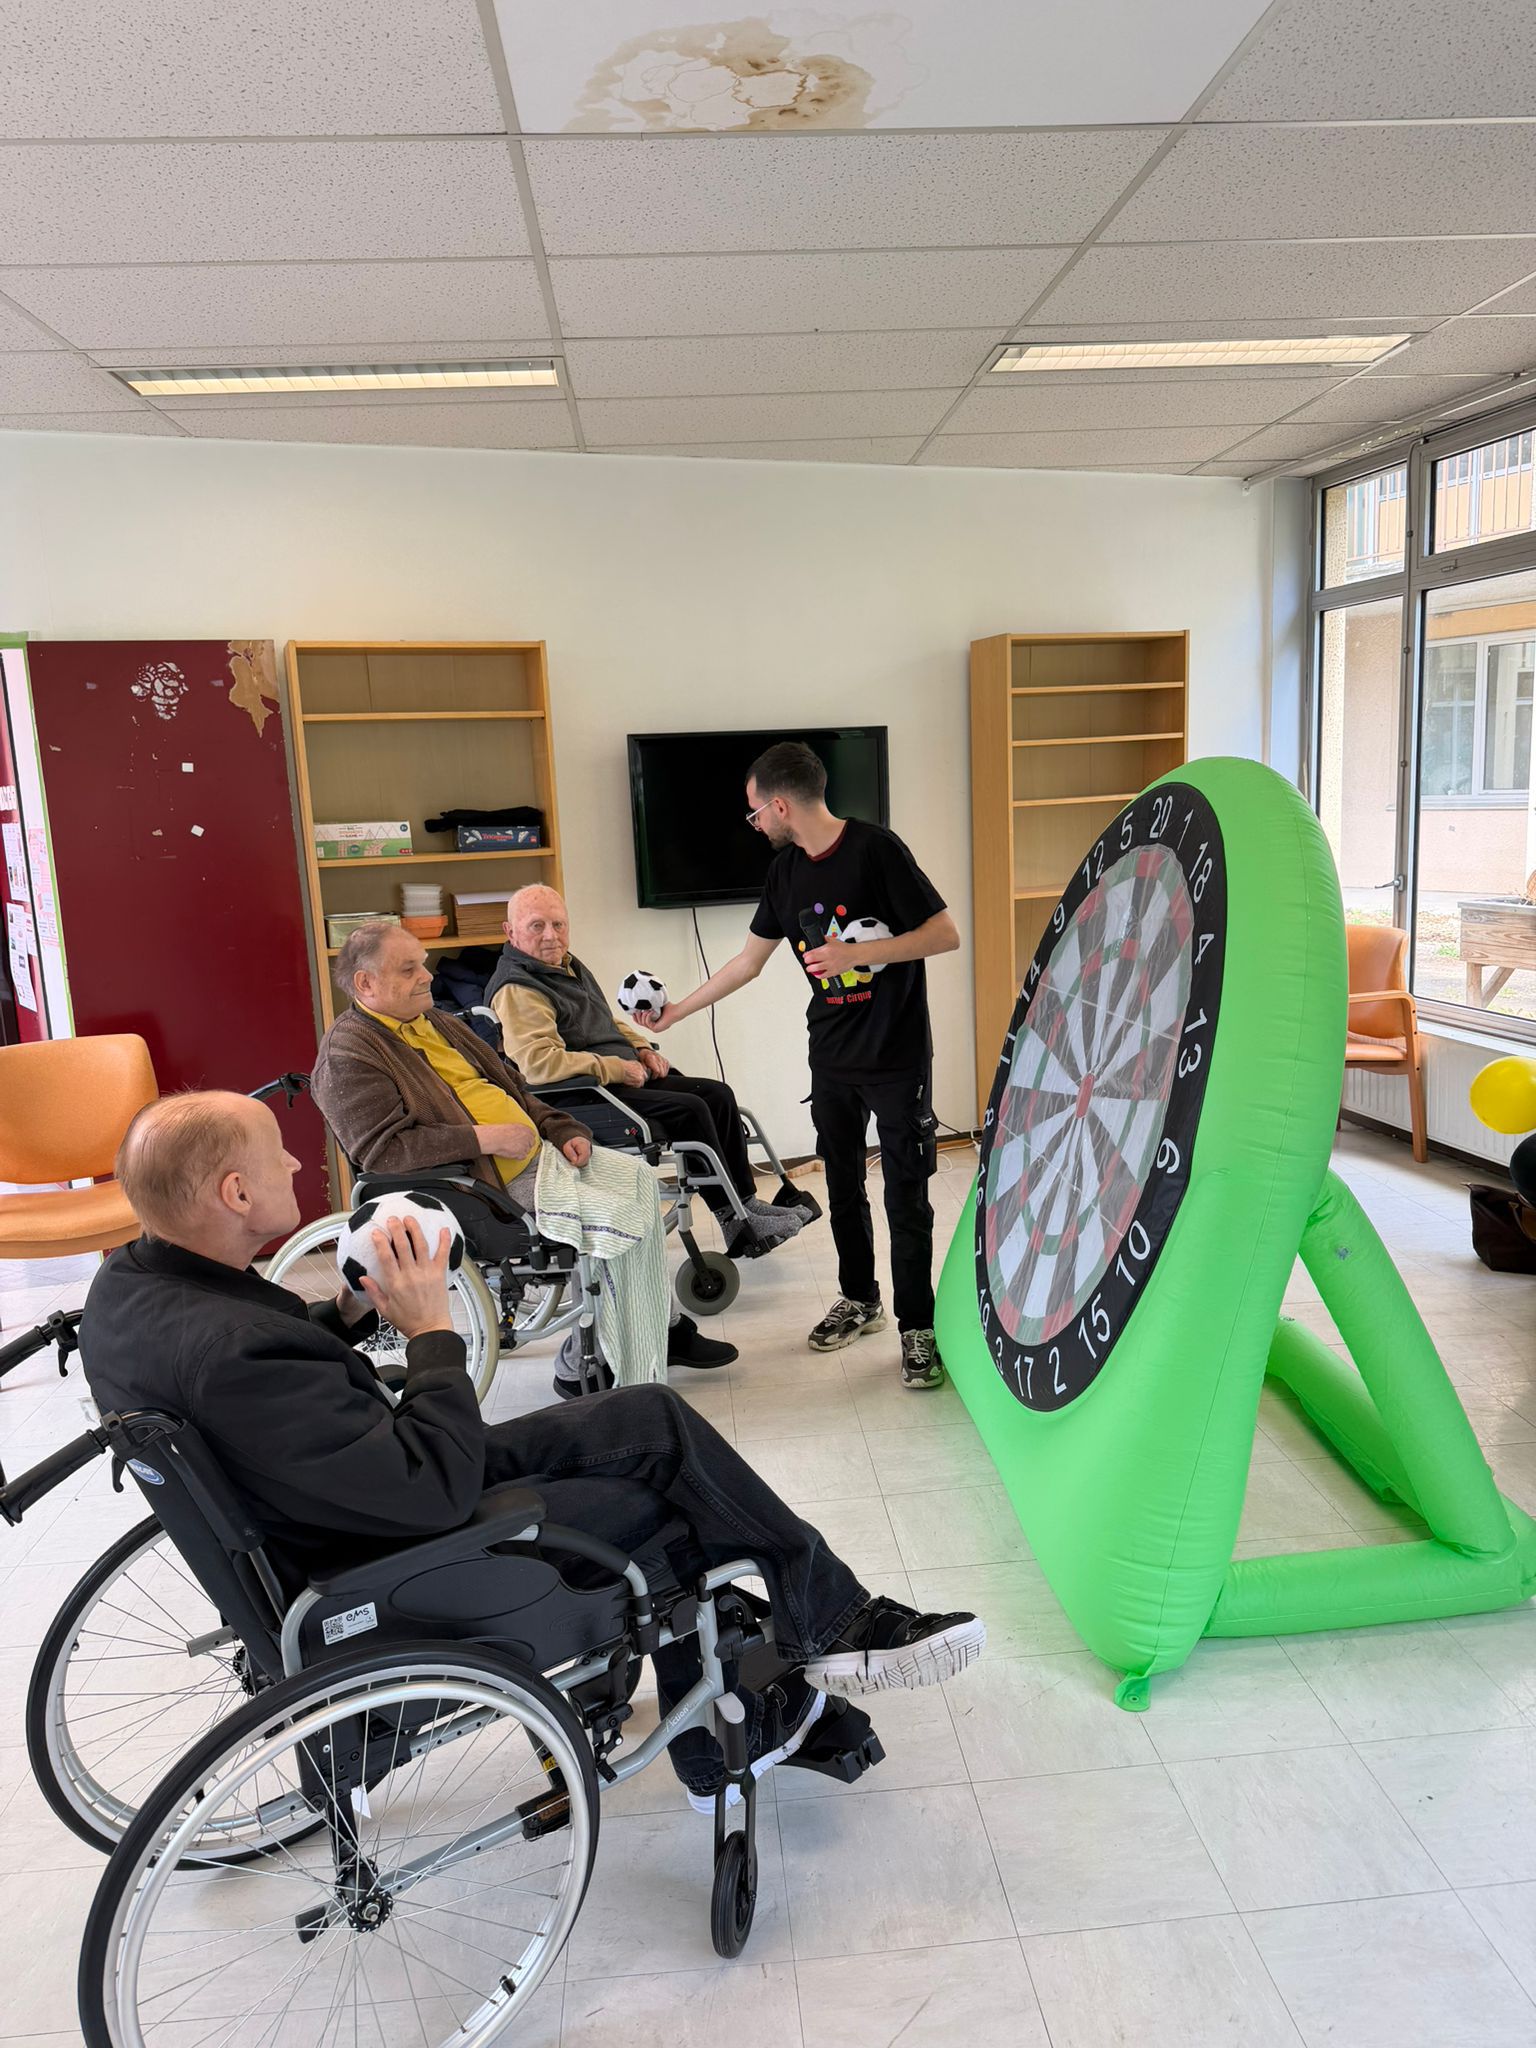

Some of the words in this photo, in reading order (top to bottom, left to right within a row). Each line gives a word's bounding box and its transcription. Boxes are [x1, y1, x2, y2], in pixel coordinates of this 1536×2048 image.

[1120, 812, 1134, 850] 5
[1149, 795, 1173, 839] 20
[1178, 809, 1194, 850] 1
[1082, 839, 1105, 889] 12
[1189, 841, 1213, 904] 18
[1053, 902, 1065, 934] 9
[1194, 932, 1215, 966] 4
[1019, 960, 1041, 1003] 14
[1178, 1007, 1208, 1079] 13
[1115, 1219, 1151, 1287] 10
[1078, 1292, 1111, 1360] 15
[995, 1336, 1004, 1375] 3
[1014, 1354, 1034, 1400] 17
[1048, 1346, 1068, 1396] 2
